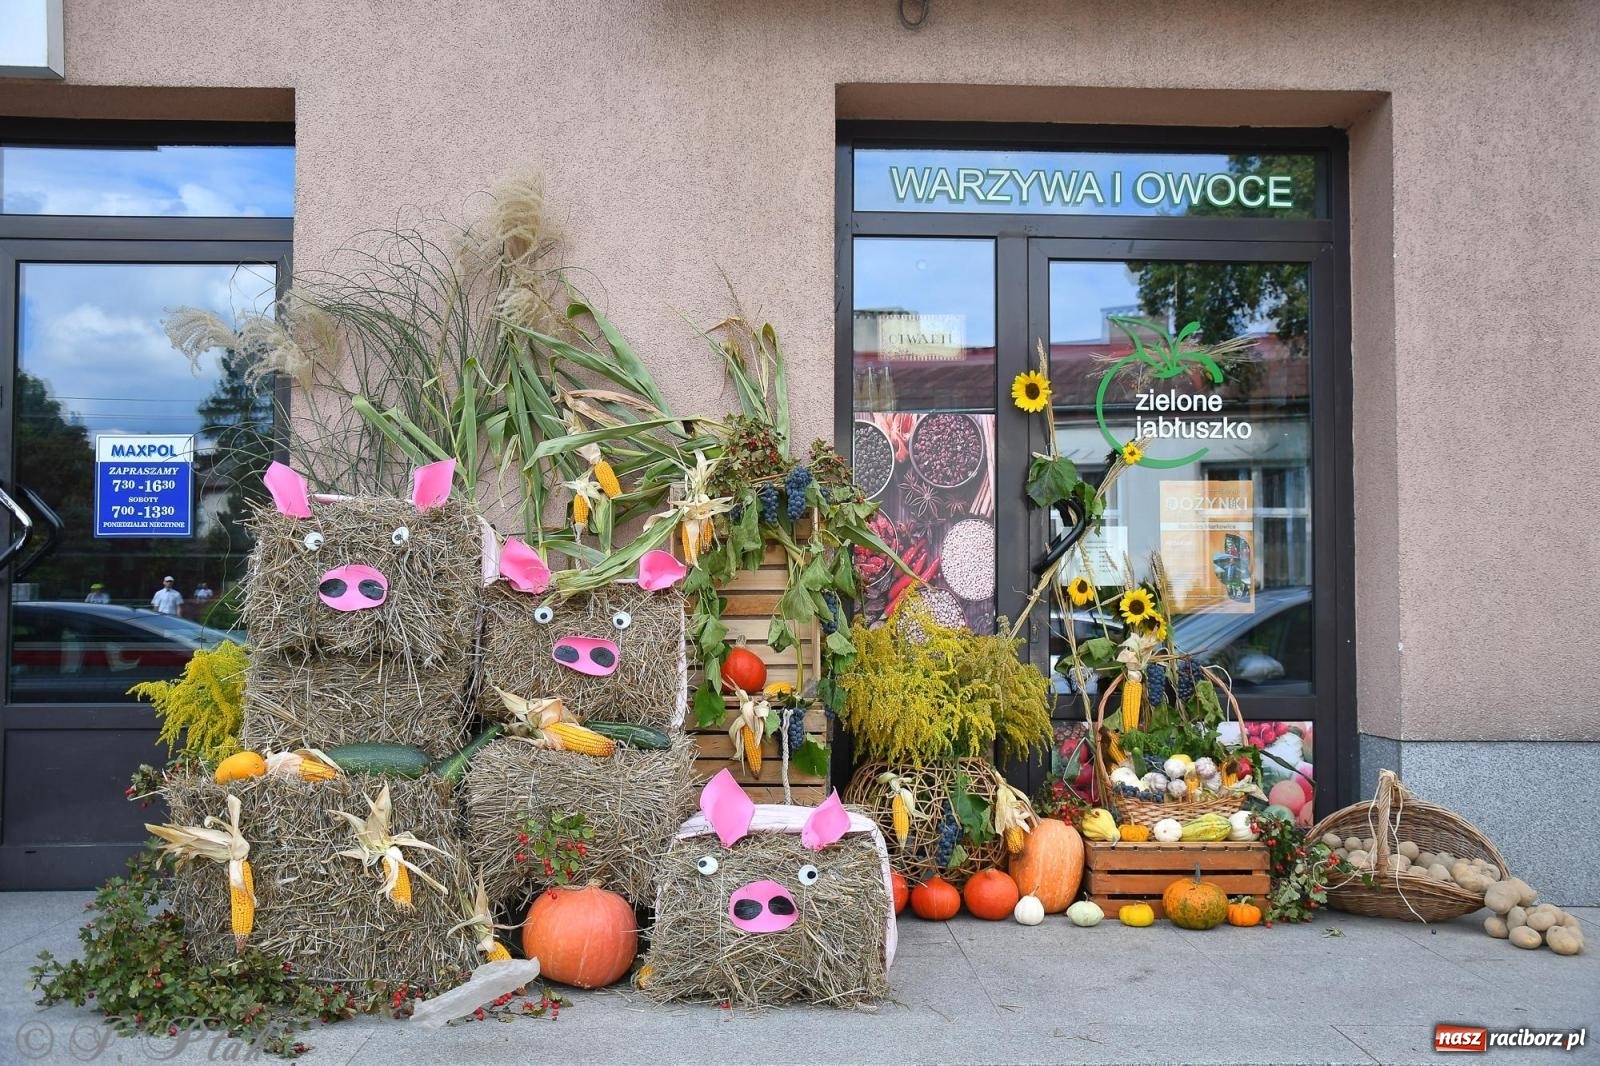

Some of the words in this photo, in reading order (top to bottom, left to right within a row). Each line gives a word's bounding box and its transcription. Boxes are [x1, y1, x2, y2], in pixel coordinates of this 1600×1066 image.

[889, 166, 1104, 204] WARZYWA
[1111, 170, 1123, 206] I
[1133, 170, 1294, 210] OWOCE
[1135, 388, 1223, 412] zielone
[1135, 415, 1252, 441] jabłuszko
[111, 444, 177, 457] MAXPOL
[108, 466, 179, 475] ZAPRASZAMY
